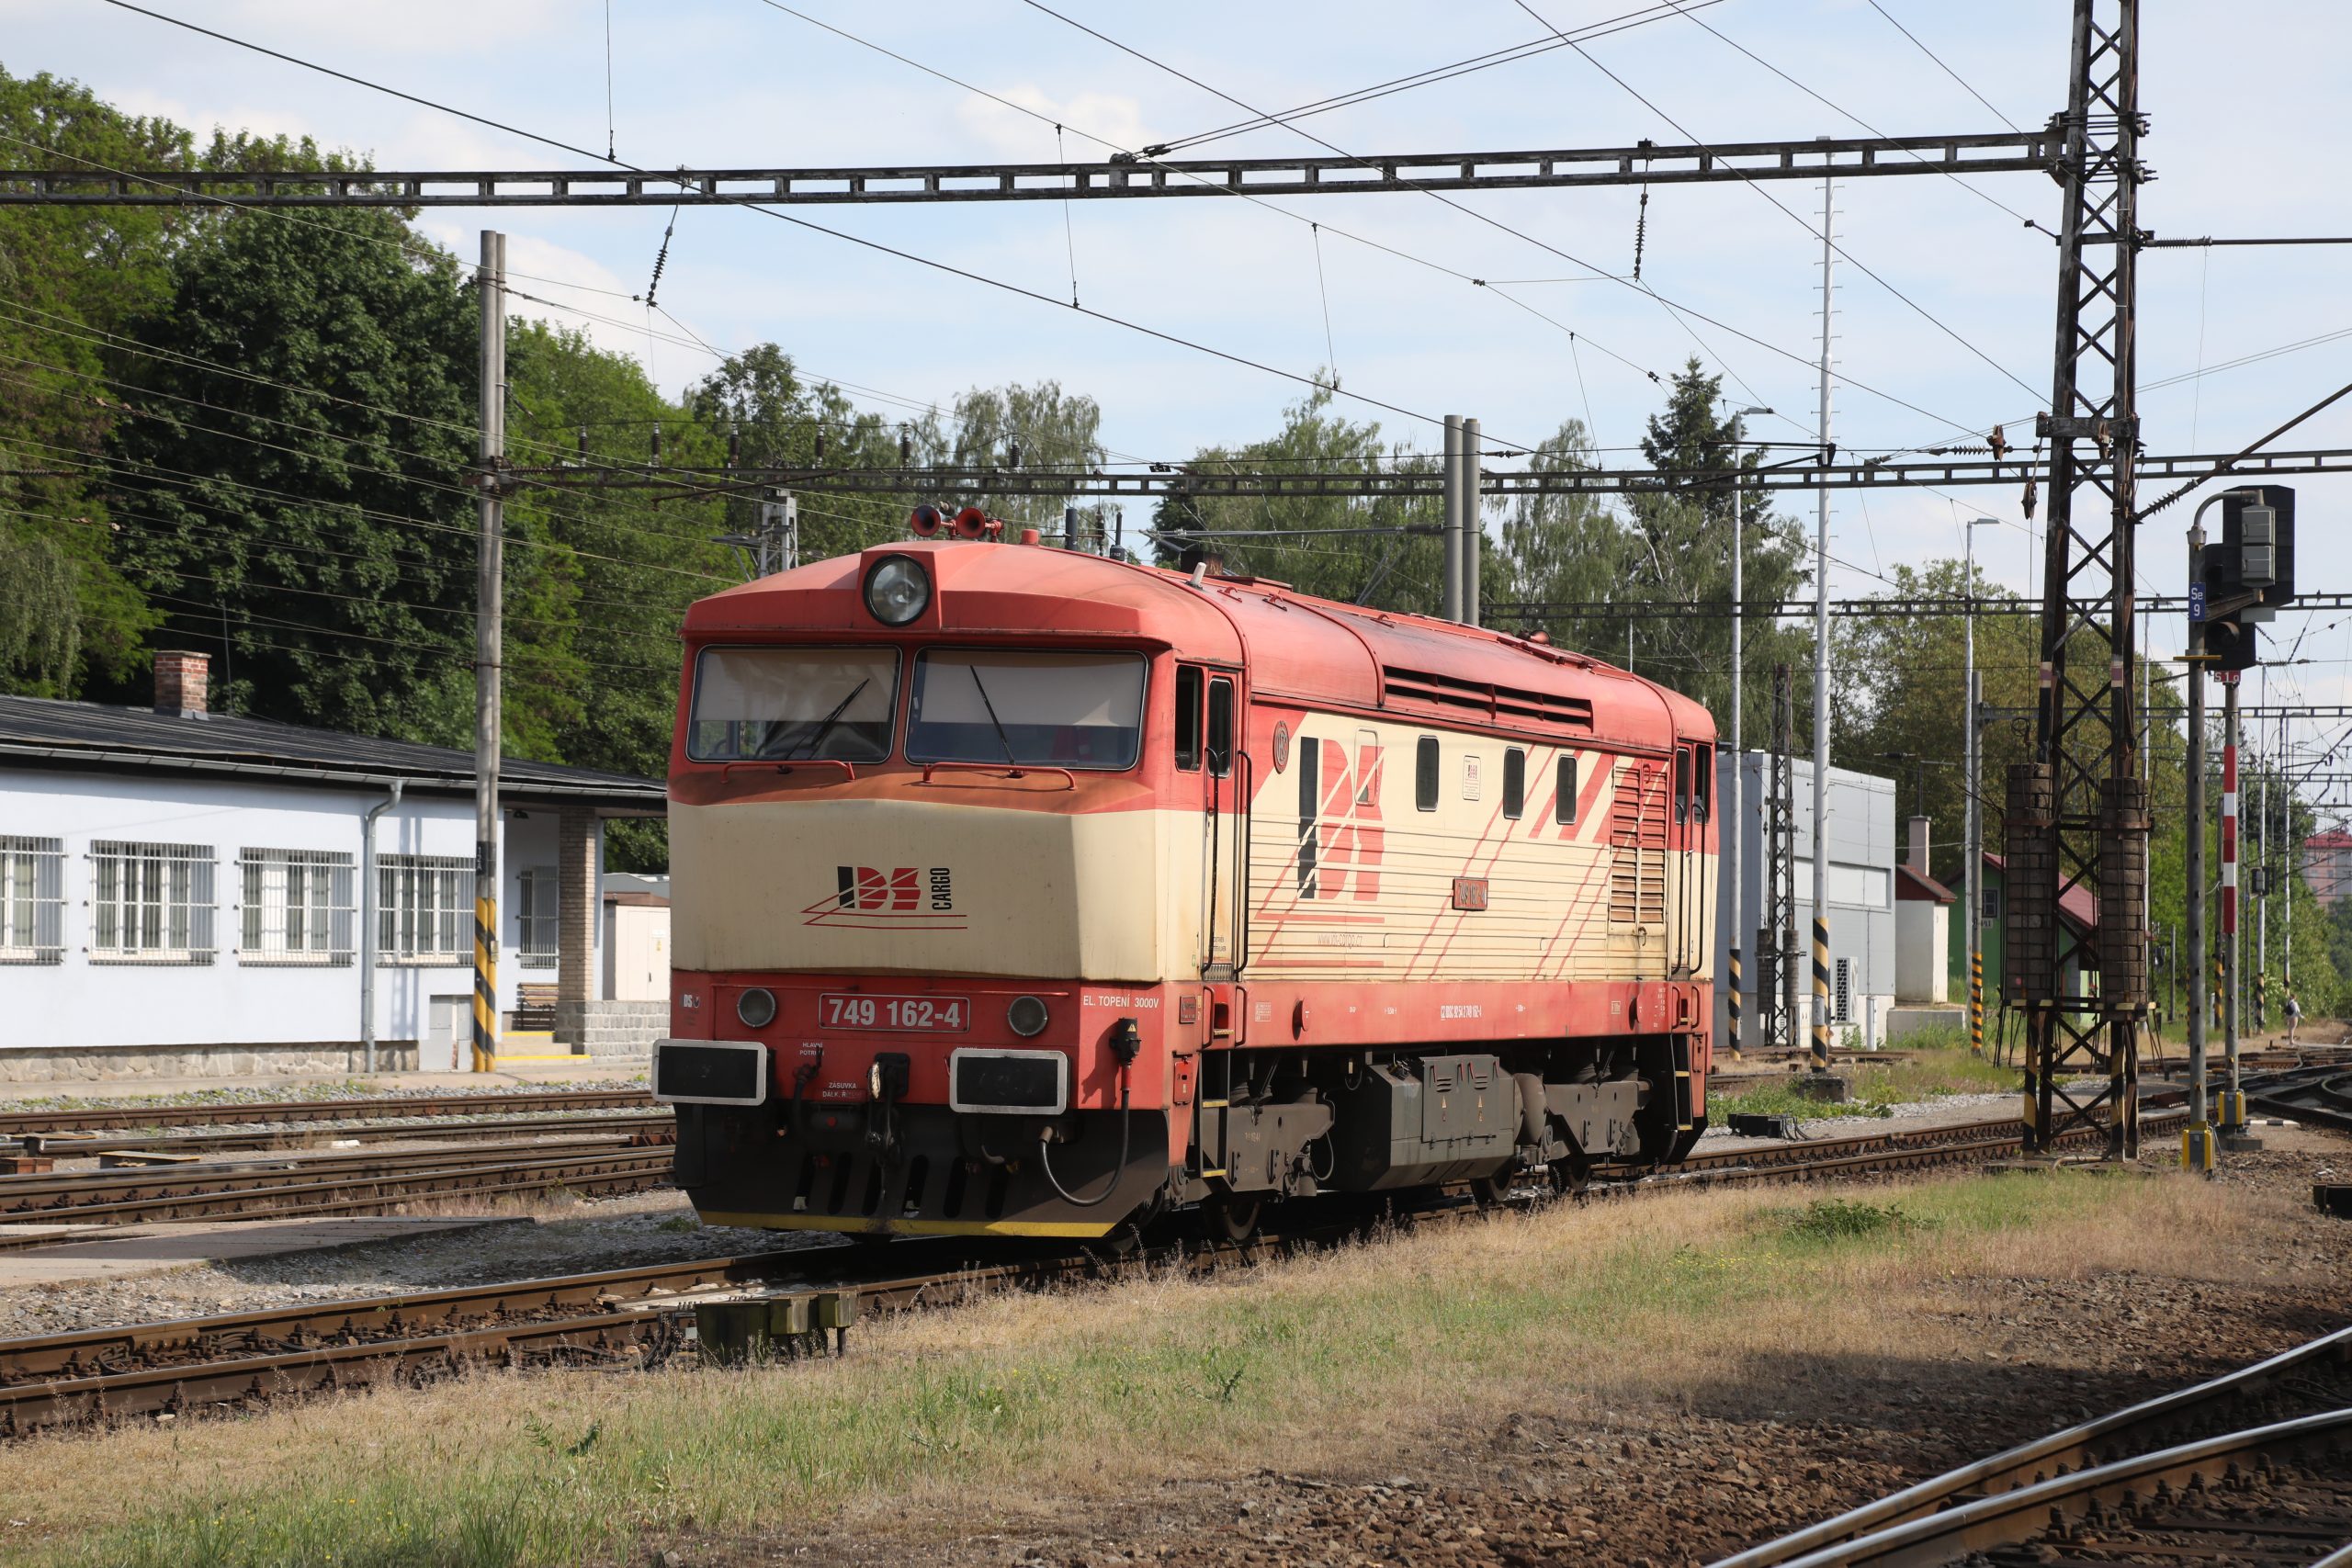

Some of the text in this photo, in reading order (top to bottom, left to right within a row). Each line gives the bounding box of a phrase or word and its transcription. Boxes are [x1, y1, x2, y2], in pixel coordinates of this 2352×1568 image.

[2190, 587, 2203, 601] Se
[2193, 604, 2200, 616] 9
[837, 865, 922, 910] IDS
[929, 867, 953, 910] CARGO
[1082, 994, 1159, 1009] EL. TOPENÍ 3000V
[829, 998, 961, 1028] 749 162-4
[829, 1081, 857, 1089] ZÁSUVKA
